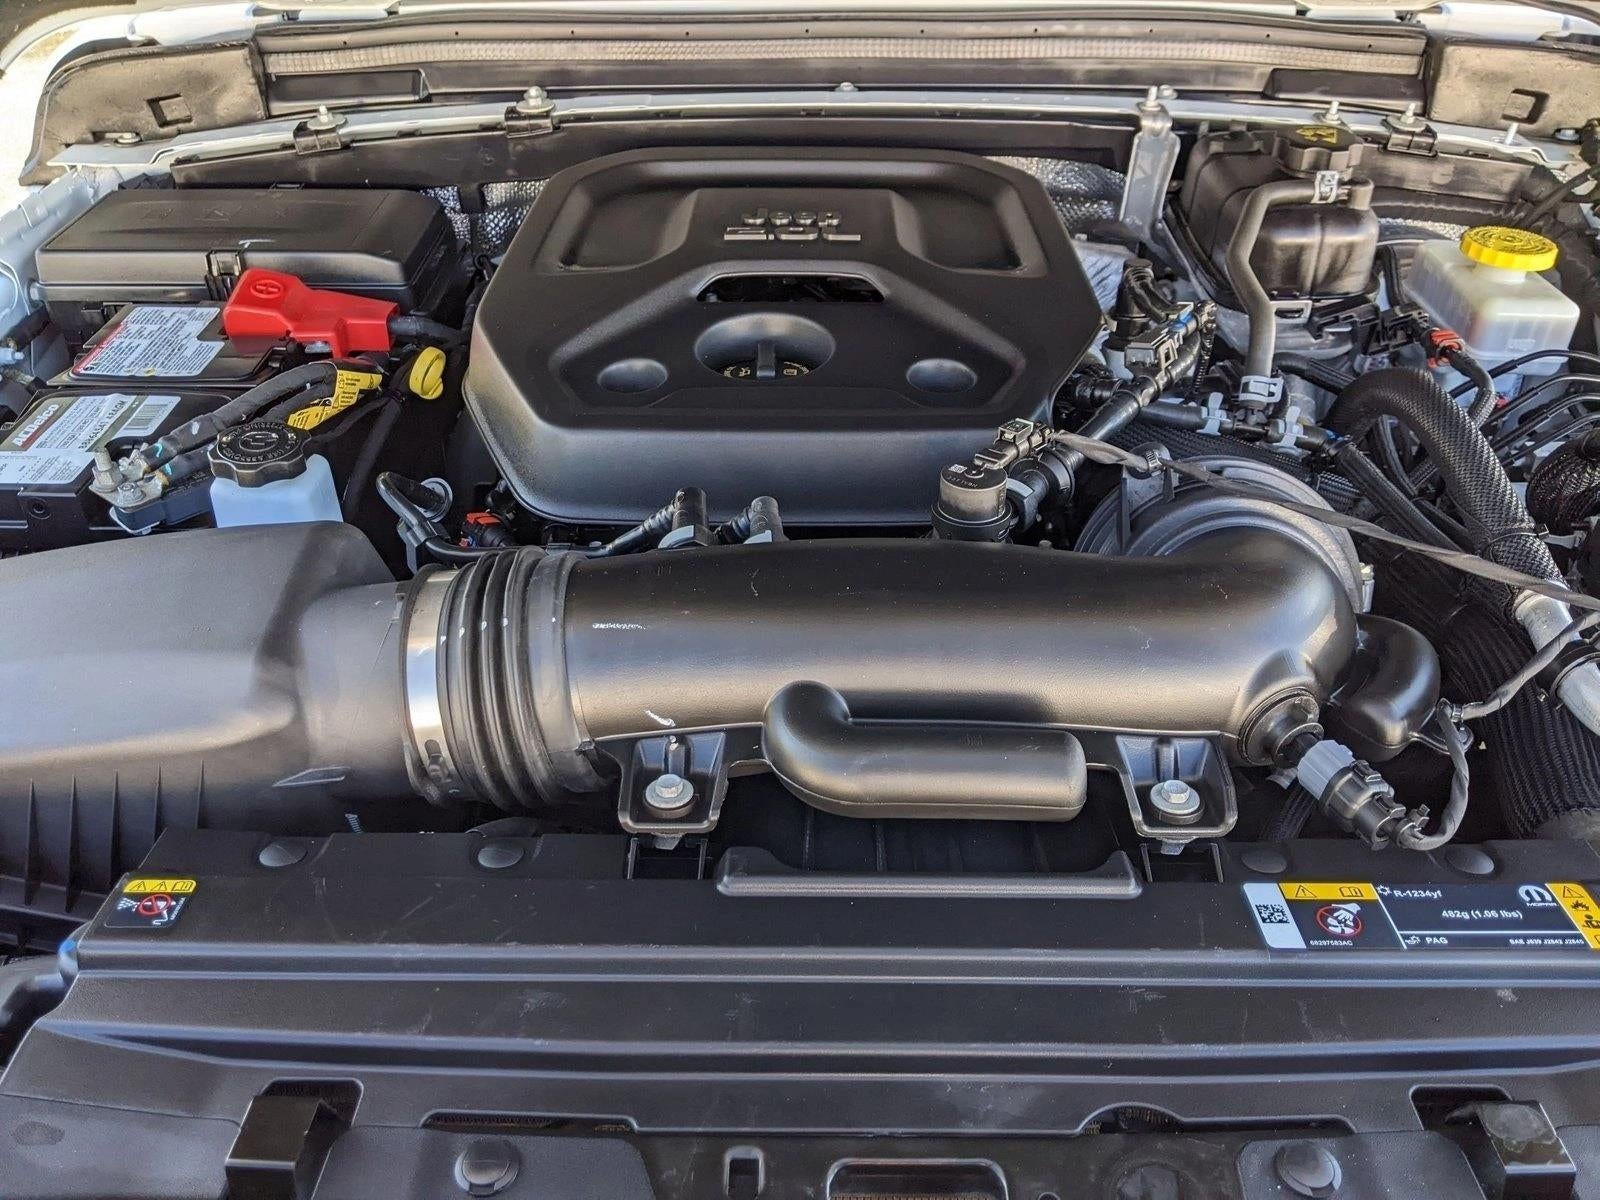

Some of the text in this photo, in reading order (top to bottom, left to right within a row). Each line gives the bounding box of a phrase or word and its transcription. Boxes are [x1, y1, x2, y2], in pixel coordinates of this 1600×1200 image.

[12, 404, 60, 447] ACDelco
[1442, 909, 1470, 920] 482g
[1499, 909, 1523, 920] lbs)
[1425, 936, 1448, 944] PAG
